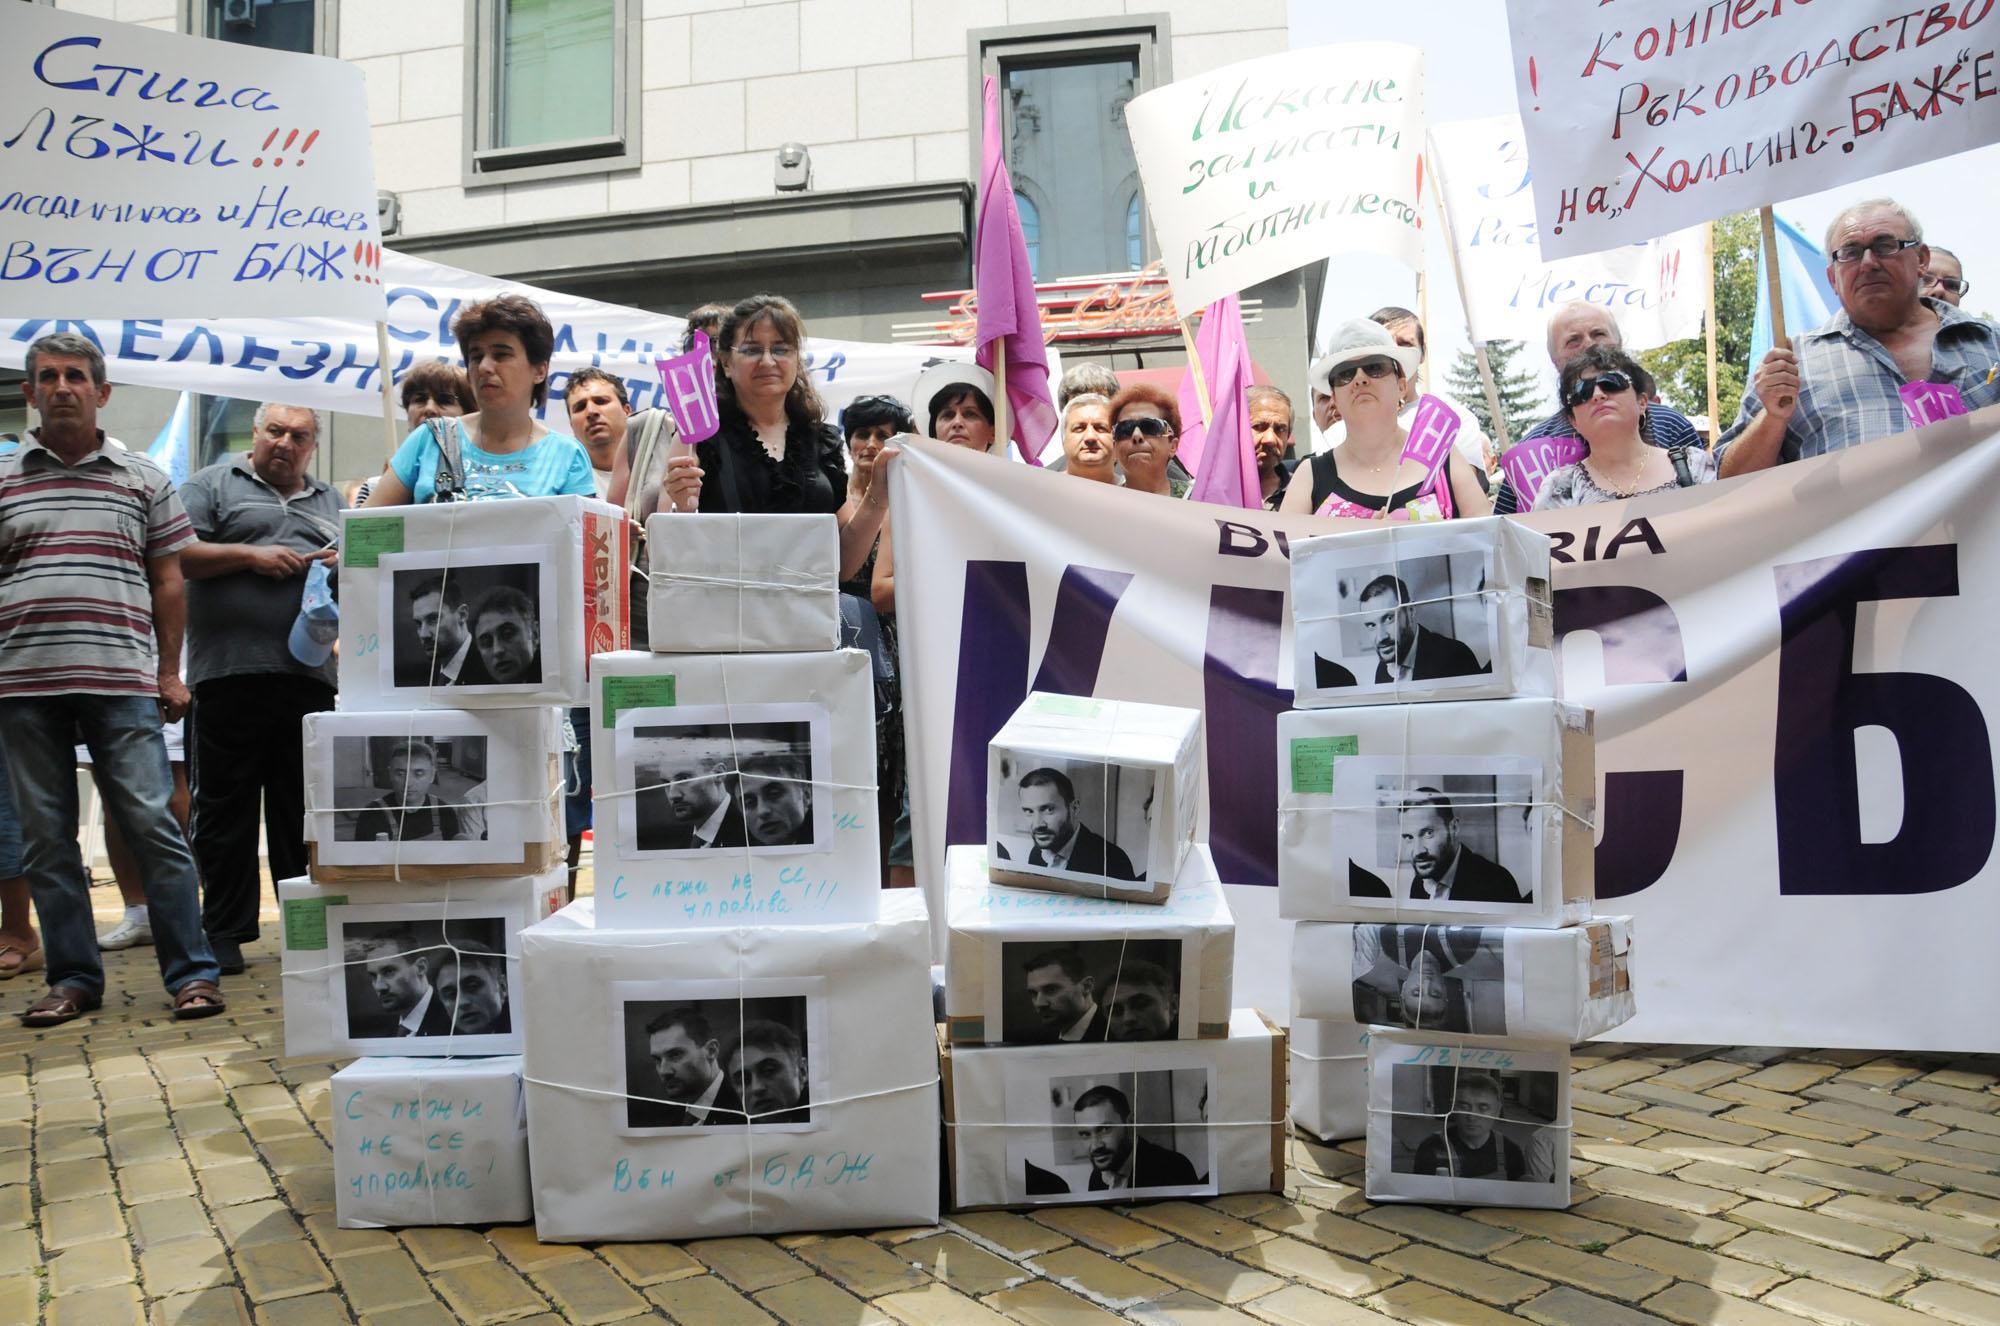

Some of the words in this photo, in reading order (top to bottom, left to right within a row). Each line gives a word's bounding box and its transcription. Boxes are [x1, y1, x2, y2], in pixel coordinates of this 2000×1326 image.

[33, 36, 280, 111] Стига
[0, 191, 201, 224] ладимиров
[240, 185, 369, 232] Недев
